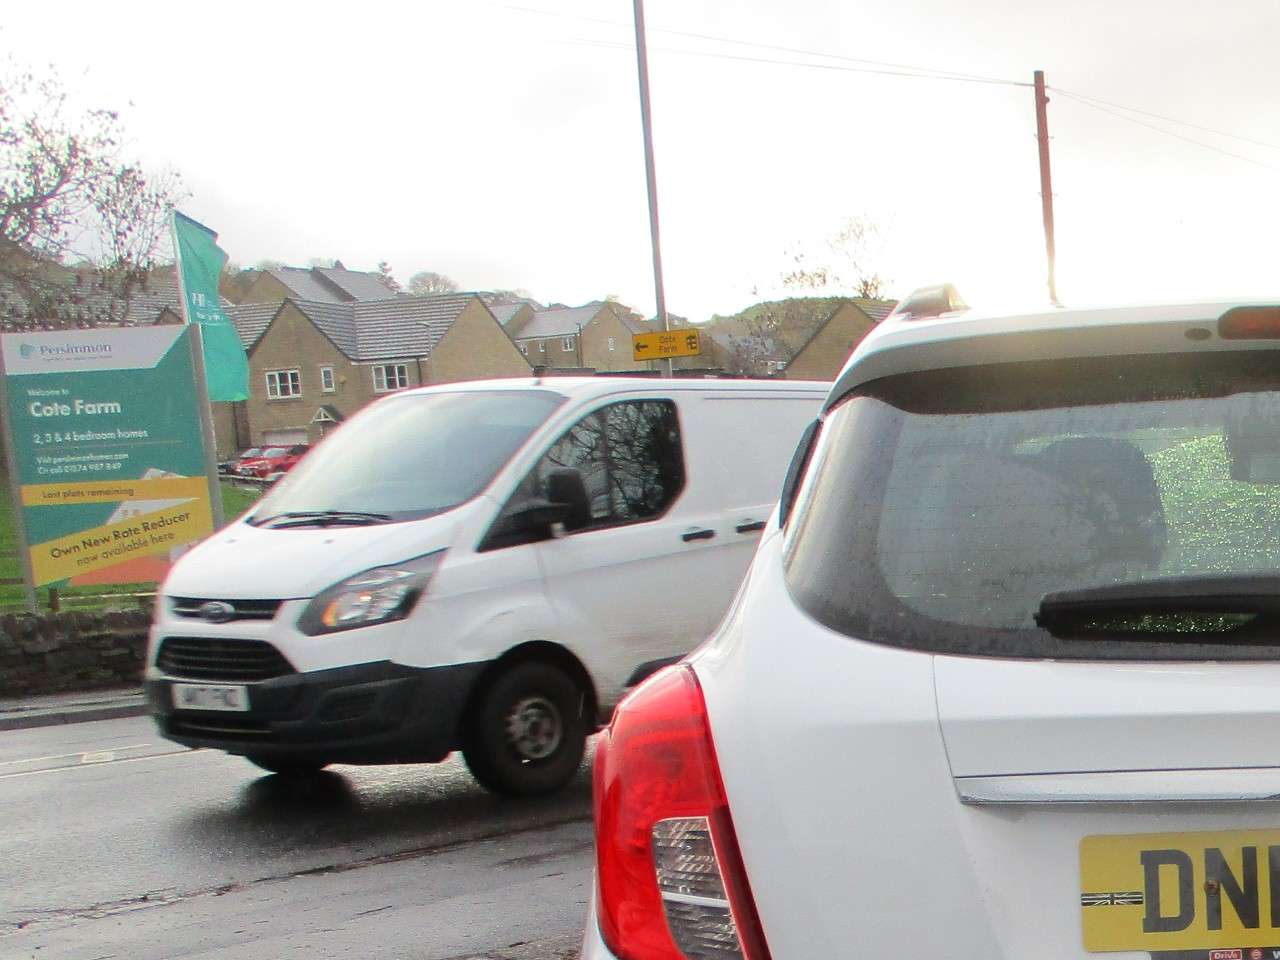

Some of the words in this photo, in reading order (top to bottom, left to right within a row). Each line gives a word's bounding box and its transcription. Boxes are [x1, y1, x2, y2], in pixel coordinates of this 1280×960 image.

[40, 343, 112, 355] Persimmon
[30, 401, 71, 417] Cote
[75, 399, 121, 415] Farm
[73, 430, 116, 441] bedroom
[117, 428, 148, 438] homes
[42, 491, 61, 499] Last
[63, 490, 85, 499] plots
[87, 488, 134, 497] remaining
[51, 545, 80, 559] Own
[82, 534, 111, 550] New
[112, 528, 140, 541] Rate
[142, 512, 190, 533] Reducer
[77, 554, 100, 567] now
[102, 540, 148, 559] available
[150, 532, 175, 545] here
[1214, 951, 1237, 960] Drive
